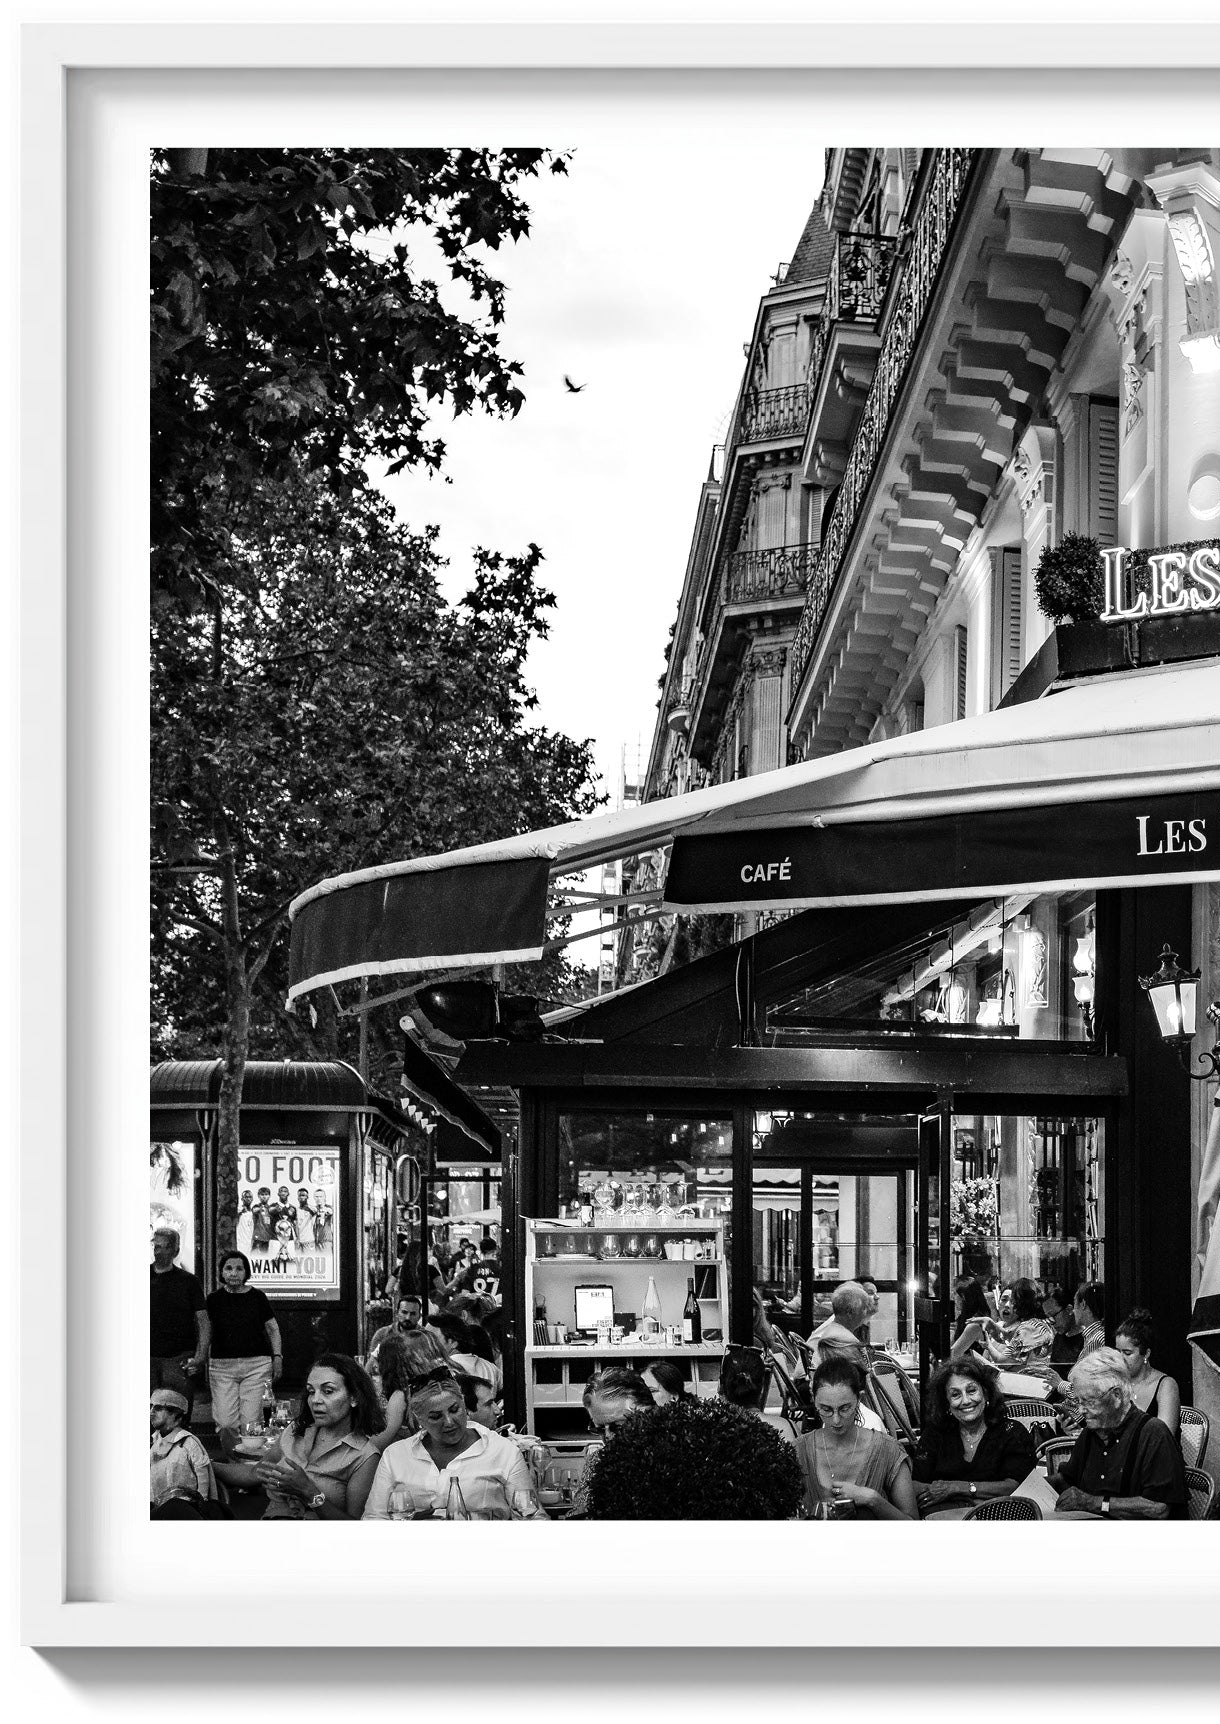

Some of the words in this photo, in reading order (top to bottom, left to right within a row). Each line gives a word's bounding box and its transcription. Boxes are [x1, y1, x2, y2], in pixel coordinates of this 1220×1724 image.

[1136, 815, 1207, 855] LES
[740, 856, 792, 883] CAFÉ
[251, 1259, 288, 1274] WANT
[295, 1257, 326, 1275] YOU
